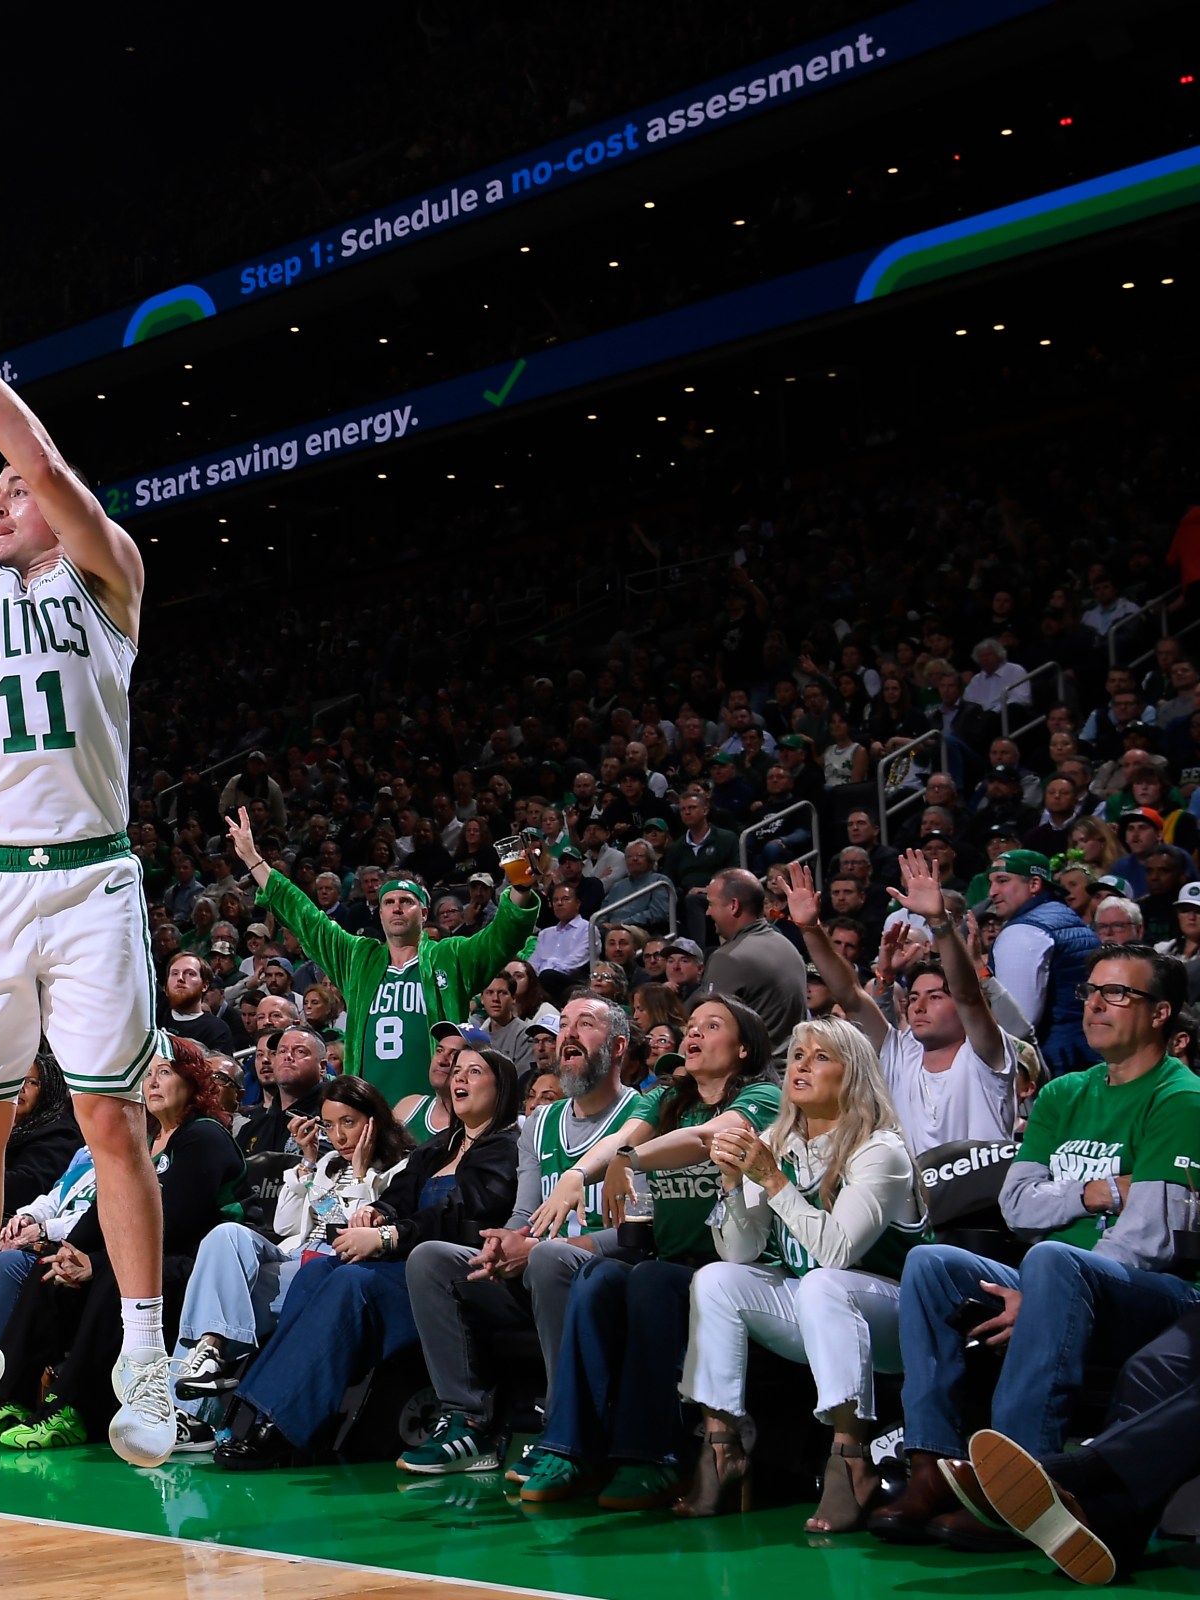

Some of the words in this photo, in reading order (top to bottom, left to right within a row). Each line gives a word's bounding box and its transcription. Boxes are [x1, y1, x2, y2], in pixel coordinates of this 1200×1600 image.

[241, 257, 301, 294] Step
[310, 242, 333, 268] 1:
[341, 188, 478, 257] Schedule
[486, 179, 504, 203] a
[511, 123, 639, 194] no-cost
[646, 33, 886, 142] assessment.
[135, 466, 200, 507] Start
[206, 444, 298, 486] saving
[305, 405, 418, 456] energy.
[375, 1016, 403, 1060] 8
